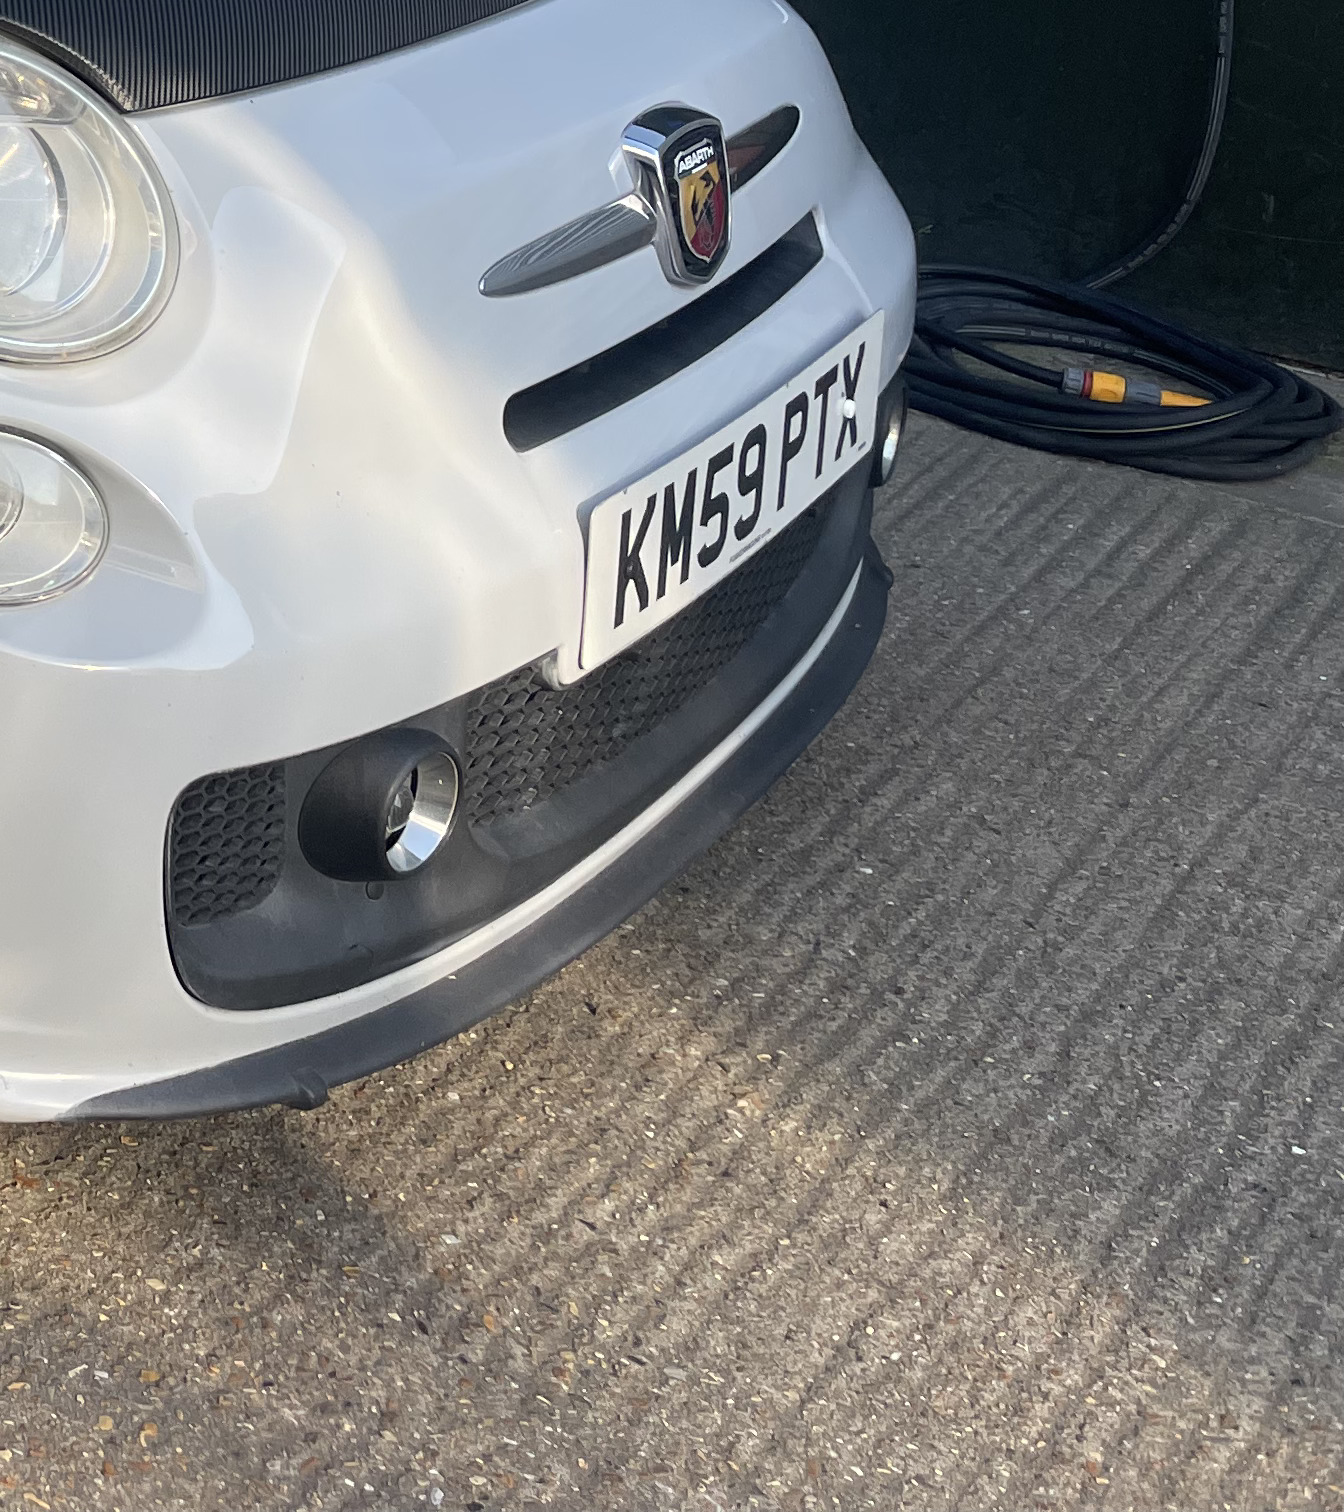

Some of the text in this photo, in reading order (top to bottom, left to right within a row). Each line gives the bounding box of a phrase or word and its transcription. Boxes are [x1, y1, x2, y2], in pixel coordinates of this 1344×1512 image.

[678, 145, 715, 174] ABARTH
[613, 340, 866, 630] KM59 PTX
